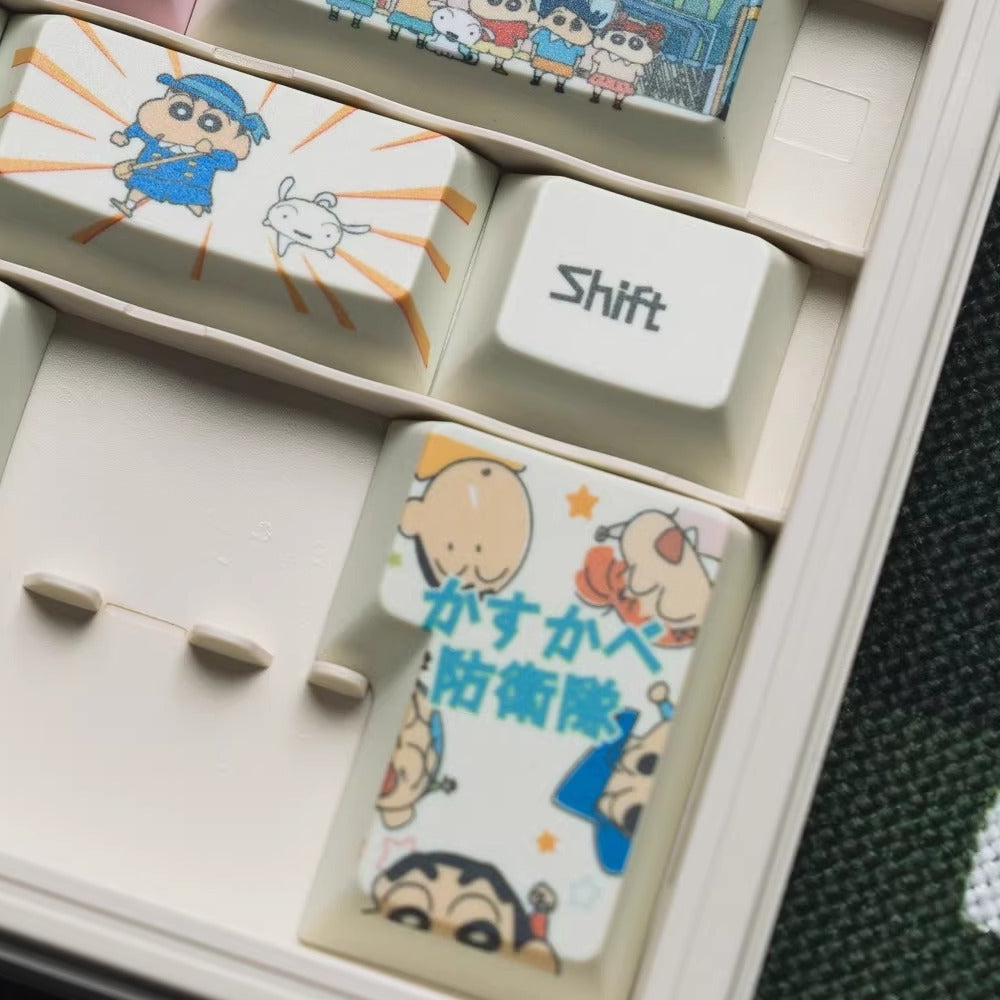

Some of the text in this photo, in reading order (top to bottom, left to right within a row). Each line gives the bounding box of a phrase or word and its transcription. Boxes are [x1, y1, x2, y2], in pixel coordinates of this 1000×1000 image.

[549, 264, 667, 332] Shift
[422, 576, 664, 675] かすかべ
[430, 645, 623, 742] 防衛隊
